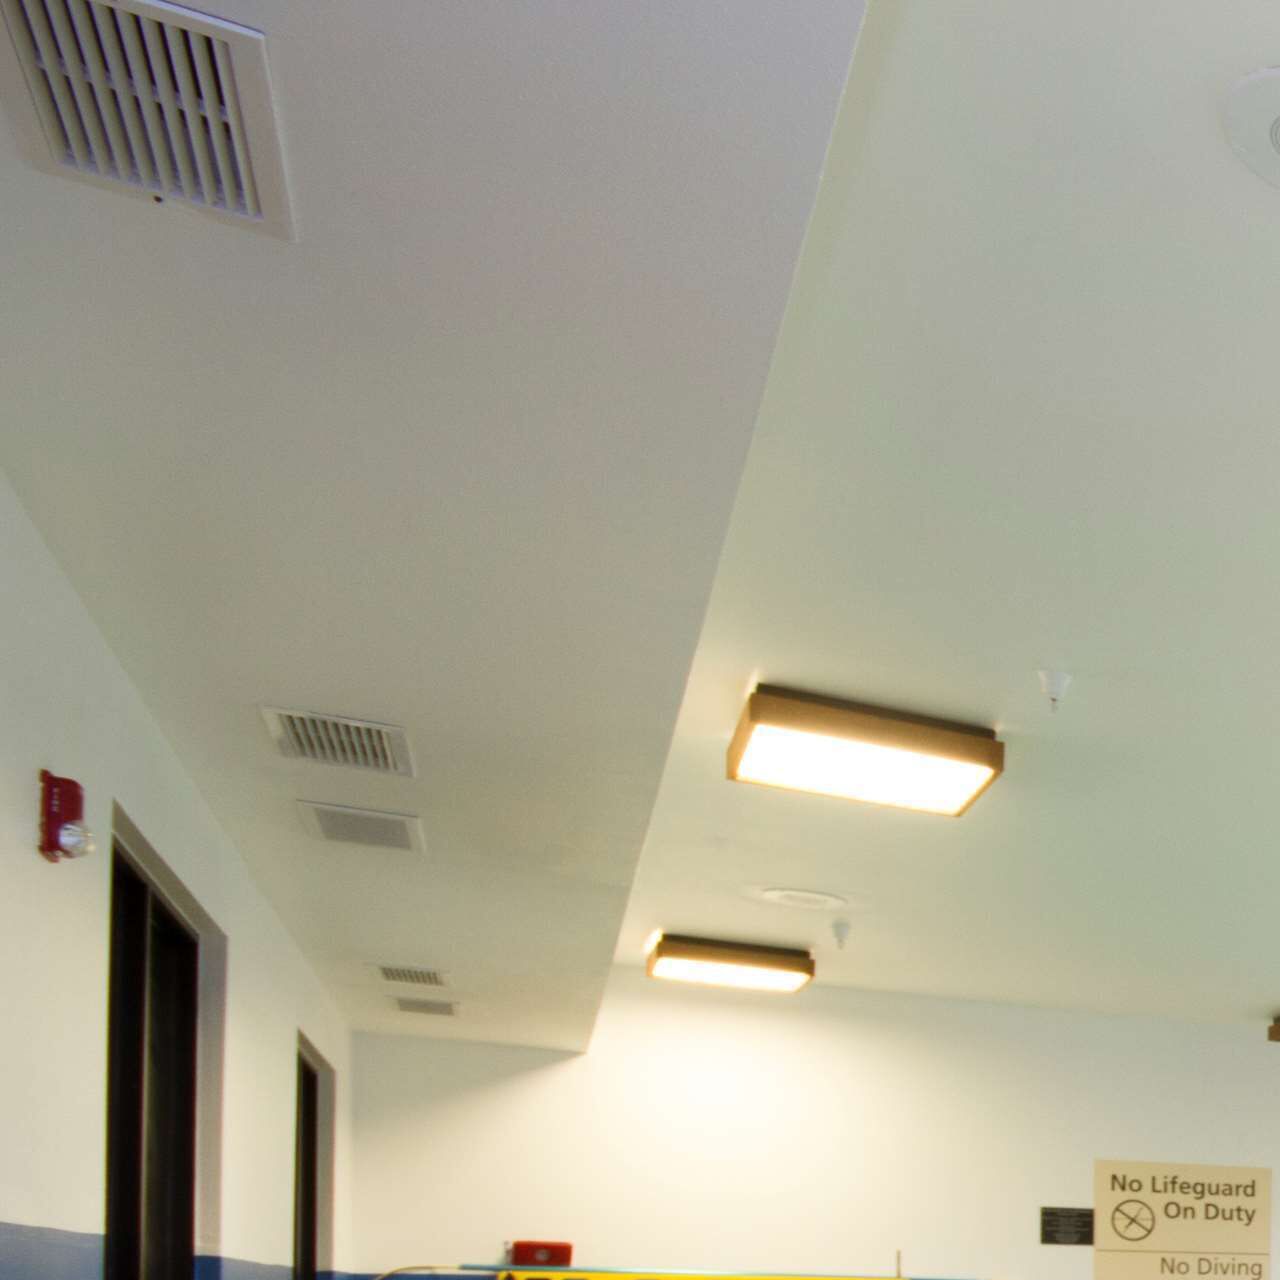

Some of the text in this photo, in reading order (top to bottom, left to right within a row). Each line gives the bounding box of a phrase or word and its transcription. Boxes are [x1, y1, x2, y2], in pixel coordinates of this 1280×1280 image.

[1110, 1174, 1256, 1200] No Lifeguard
[1163, 1201, 1256, 1226] On Duty
[1160, 1257, 1263, 1280] No Diving
